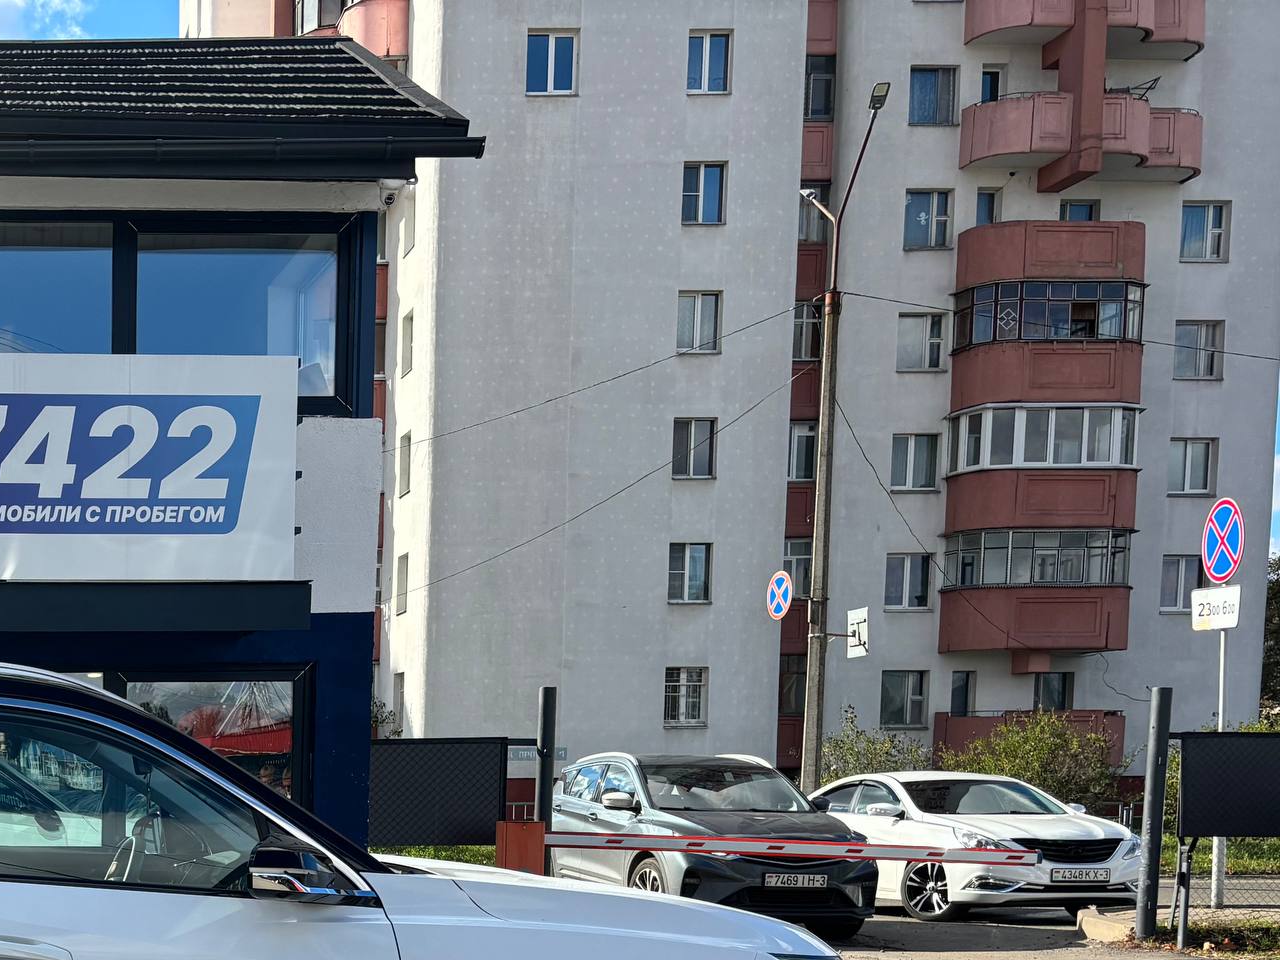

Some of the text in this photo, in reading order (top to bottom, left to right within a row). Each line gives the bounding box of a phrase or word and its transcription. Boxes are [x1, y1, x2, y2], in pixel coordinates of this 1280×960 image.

[85, 504, 100, 523] С
[105, 505, 225, 523] ПРОБЕГОМ
[774, 875, 798, 886] 7469
